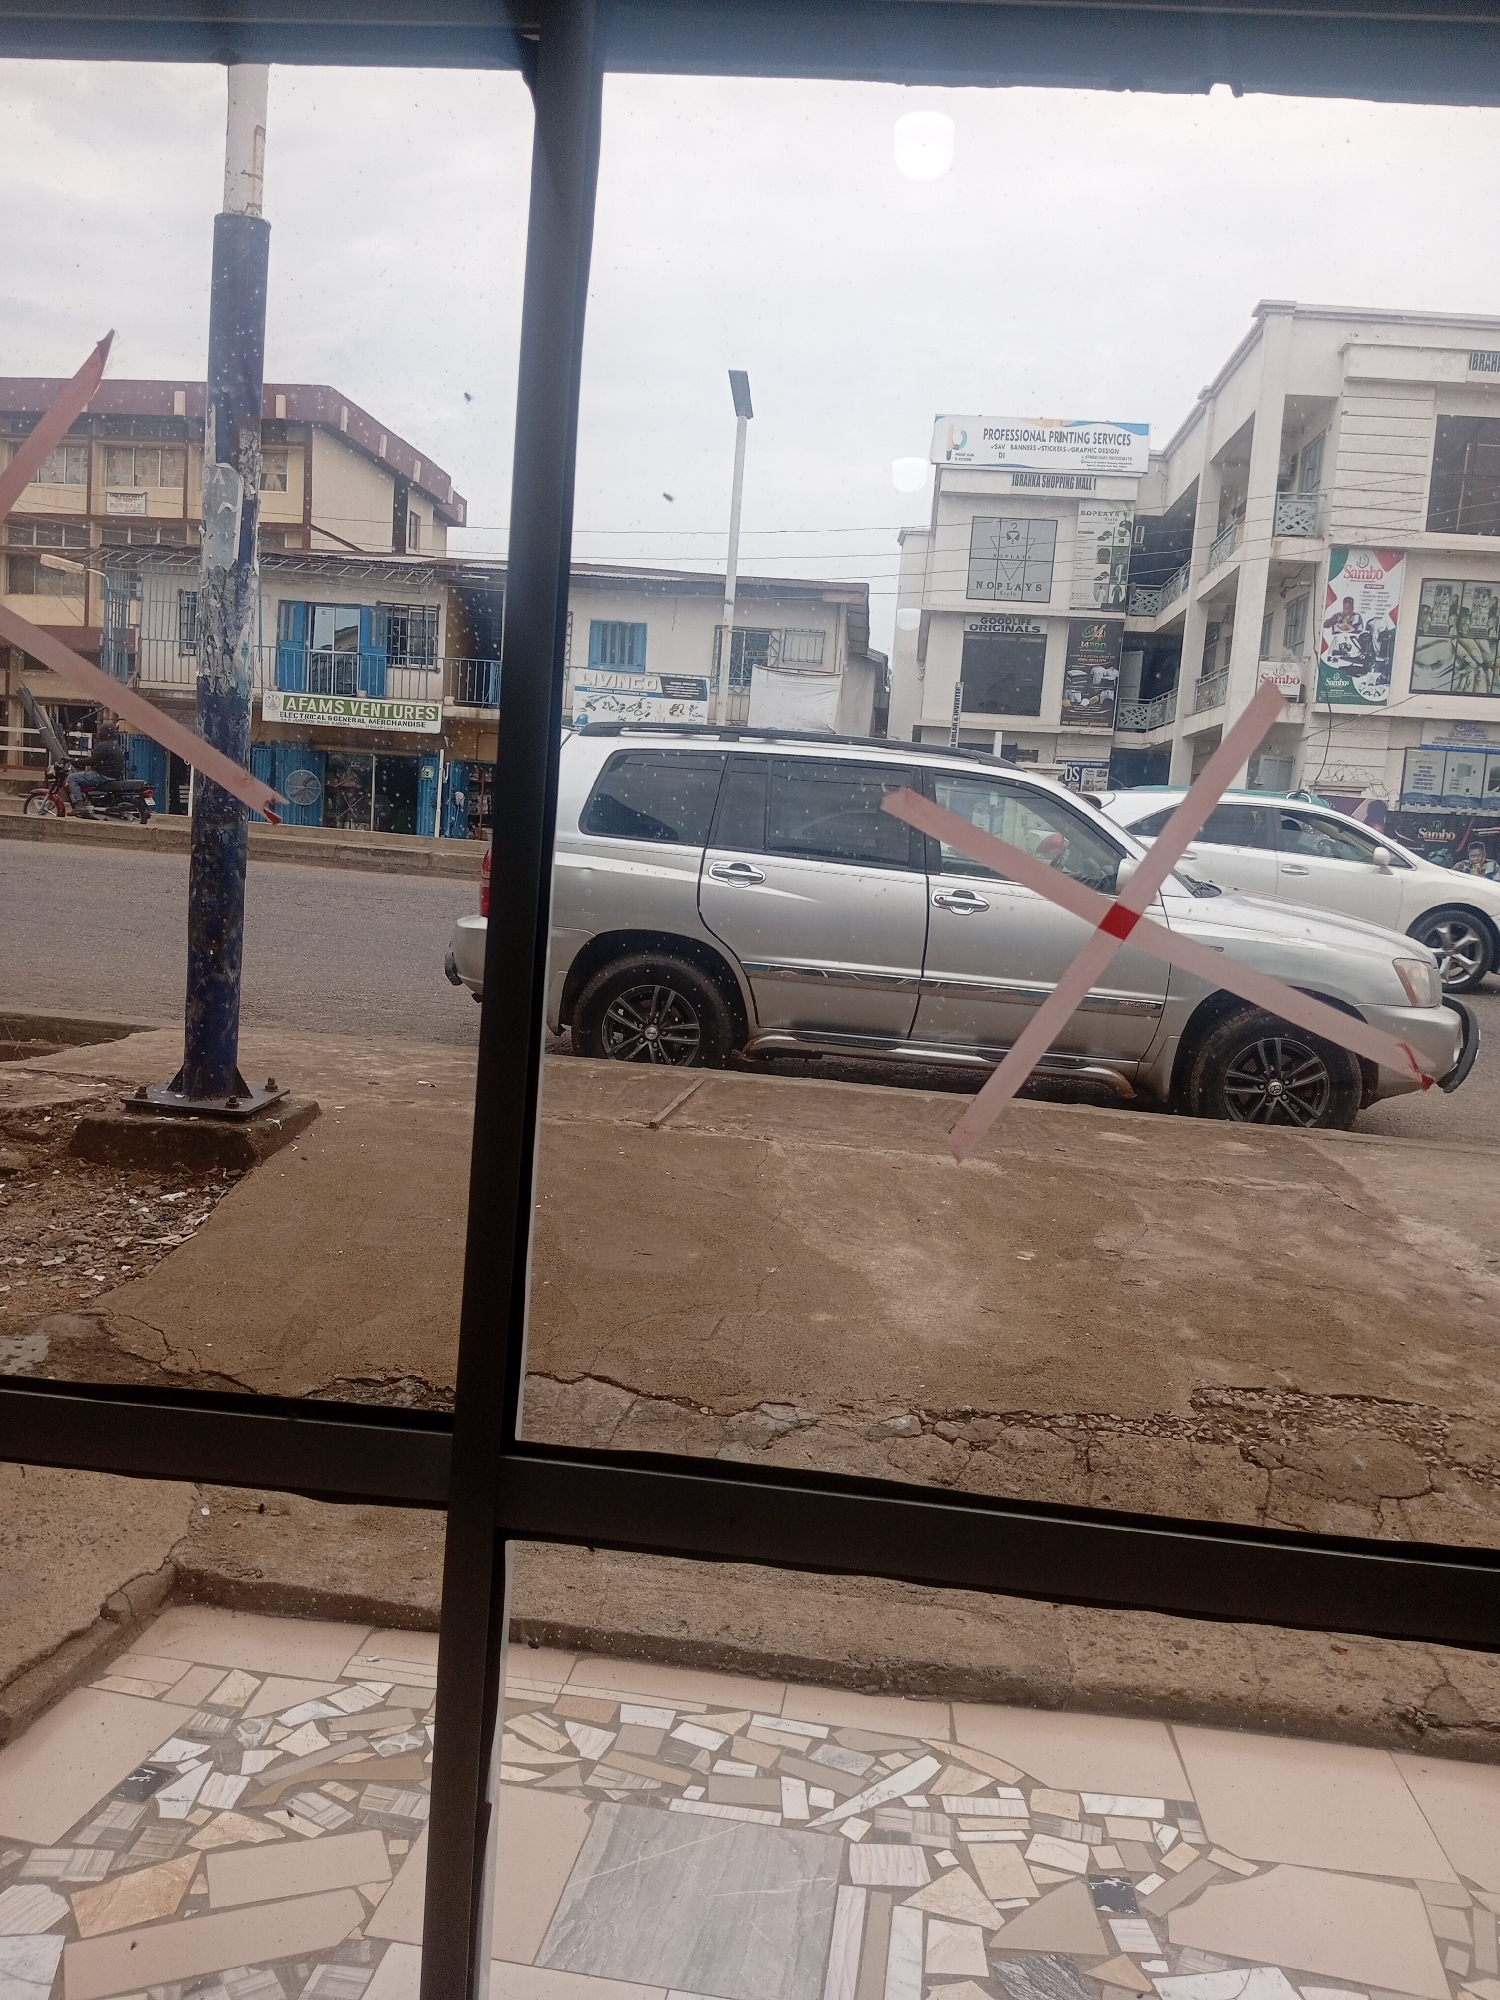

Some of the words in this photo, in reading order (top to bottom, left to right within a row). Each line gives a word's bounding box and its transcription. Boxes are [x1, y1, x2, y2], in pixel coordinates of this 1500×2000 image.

[1469, 352, 1500, 372] IBRAH
[983, 428, 1046, 442] PROFESSIONAL
[1049, 430, 1090, 444] PRINTING
[1092, 432, 1131, 446] SERVICES
[1042, 475, 1074, 489] SHOPPING
[1075, 476, 1091, 490] MALL
[1343, 564, 1384, 580] Sambo
[975, 581, 1042, 592] NOPLAYS
[969, 624, 1041, 633] ORIGINALS
[980, 617, 1032, 626] GOODLIFE
[1260, 672, 1301, 685] Sambo
[285, 697, 345, 714] AFAMS
[349, 701, 436, 720] VENTURES
[279, 711, 326, 721] ELECTRICAL
[368, 718, 426, 728] MERCHANDISE
[1418, 827, 1456, 841] Sambo
